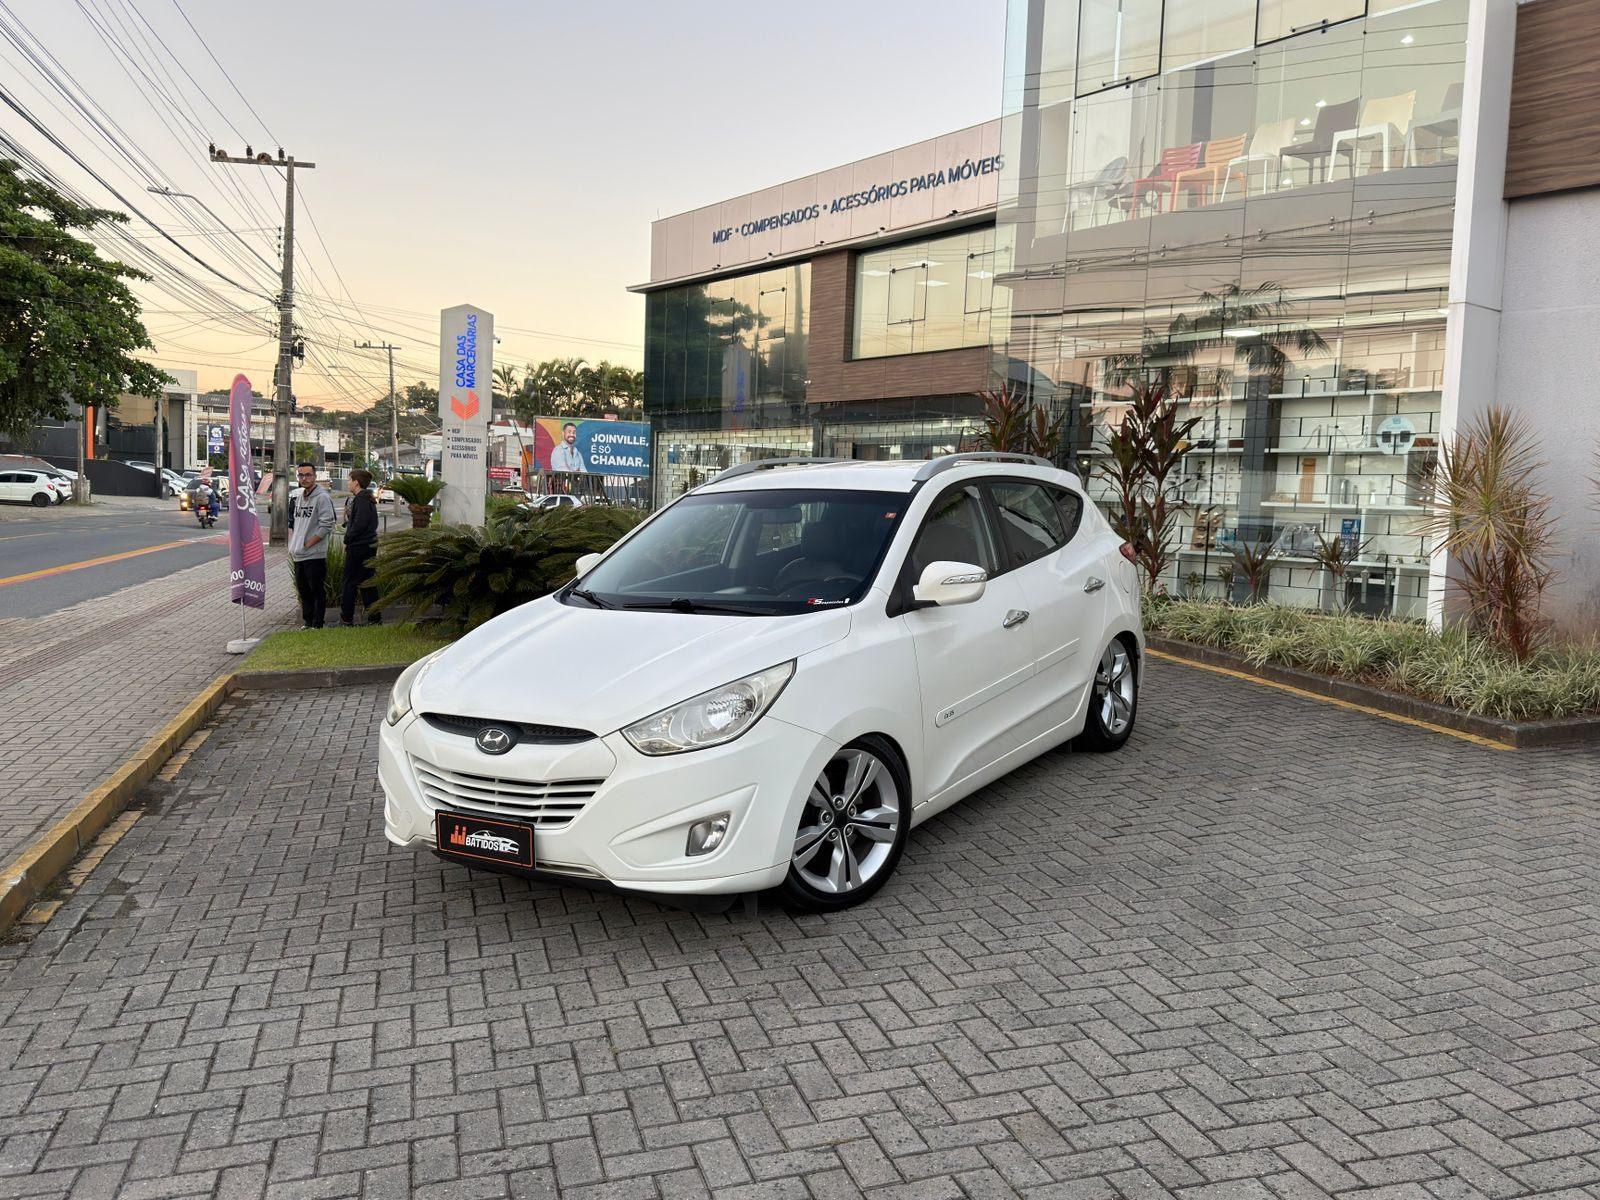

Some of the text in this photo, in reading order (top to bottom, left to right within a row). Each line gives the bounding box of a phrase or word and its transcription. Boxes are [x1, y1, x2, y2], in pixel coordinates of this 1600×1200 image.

[712, 154, 1005, 244] MDF COMPENSADOS ACESSÓRIOS PARA MÓVEIS
[456, 335, 467, 388] CASA DAS
[466, 314, 477, 389] MARCENARIAS
[590, 444, 612, 454] É SÓ
[591, 433, 649, 447] JOINVILLE,
